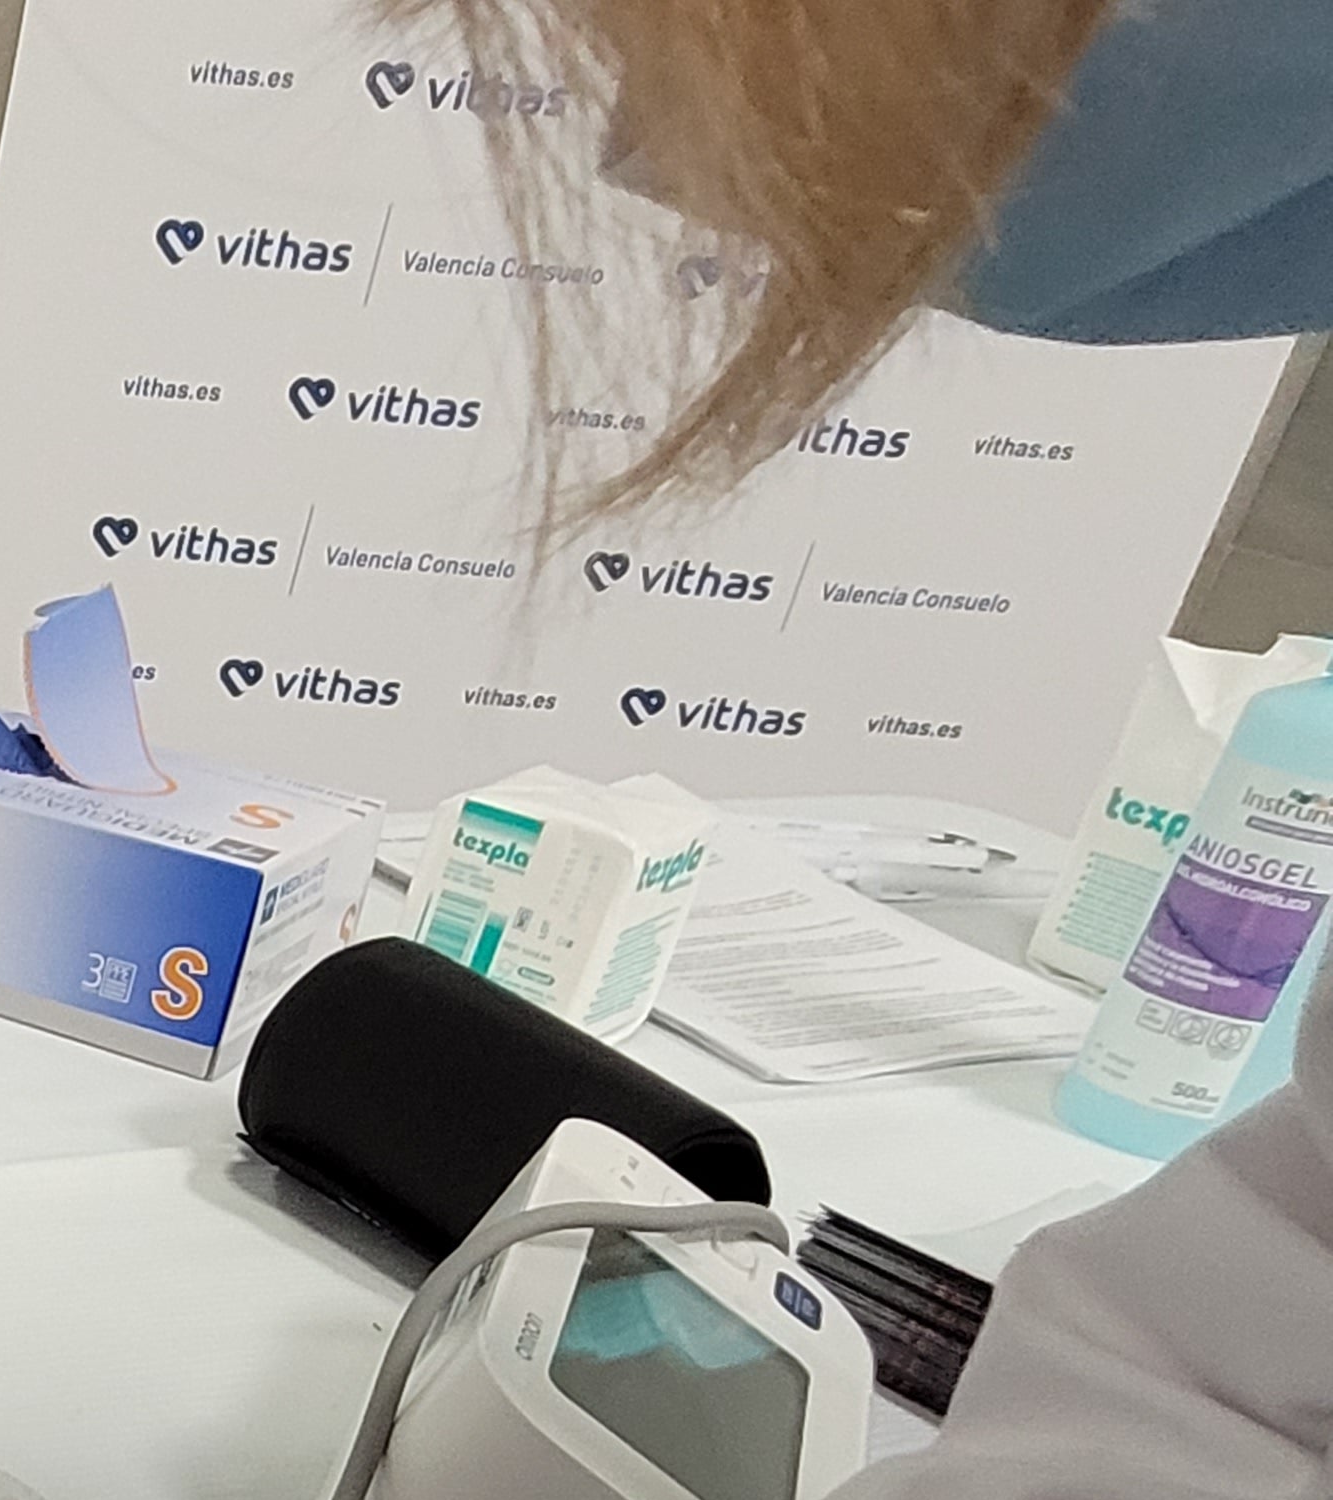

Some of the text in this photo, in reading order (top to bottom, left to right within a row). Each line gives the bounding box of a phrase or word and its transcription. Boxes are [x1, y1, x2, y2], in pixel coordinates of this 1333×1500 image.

[190, 60, 294, 90] vithas.es
[217, 228, 353, 273] vithas
[404, 249, 495, 277] Valencia
[123, 373, 222, 402] vithas.es
[347, 385, 481, 428] vithas
[798, 417, 910, 458] ithas
[974, 435, 1074, 461] vithas.es
[151, 525, 278, 566] vithas
[327, 546, 515, 579] Valencia Consuelo
[641, 561, 774, 601] vithas
[822, 582, 1010, 614] Valencia Consuelo
[275, 668, 400, 706] vithas
[464, 687, 556, 710] vithas.es
[677, 698, 805, 736] vithas
[867, 716, 962, 740] vithas.es
[1106, 787, 1191, 847] texp
[453, 827, 530, 869] texpla
[637, 838, 705, 892] texpla
[1188, 833, 1318, 889] ANIOSGEL
[81, 952, 105, 988] 3
[151, 946, 208, 1020] S
